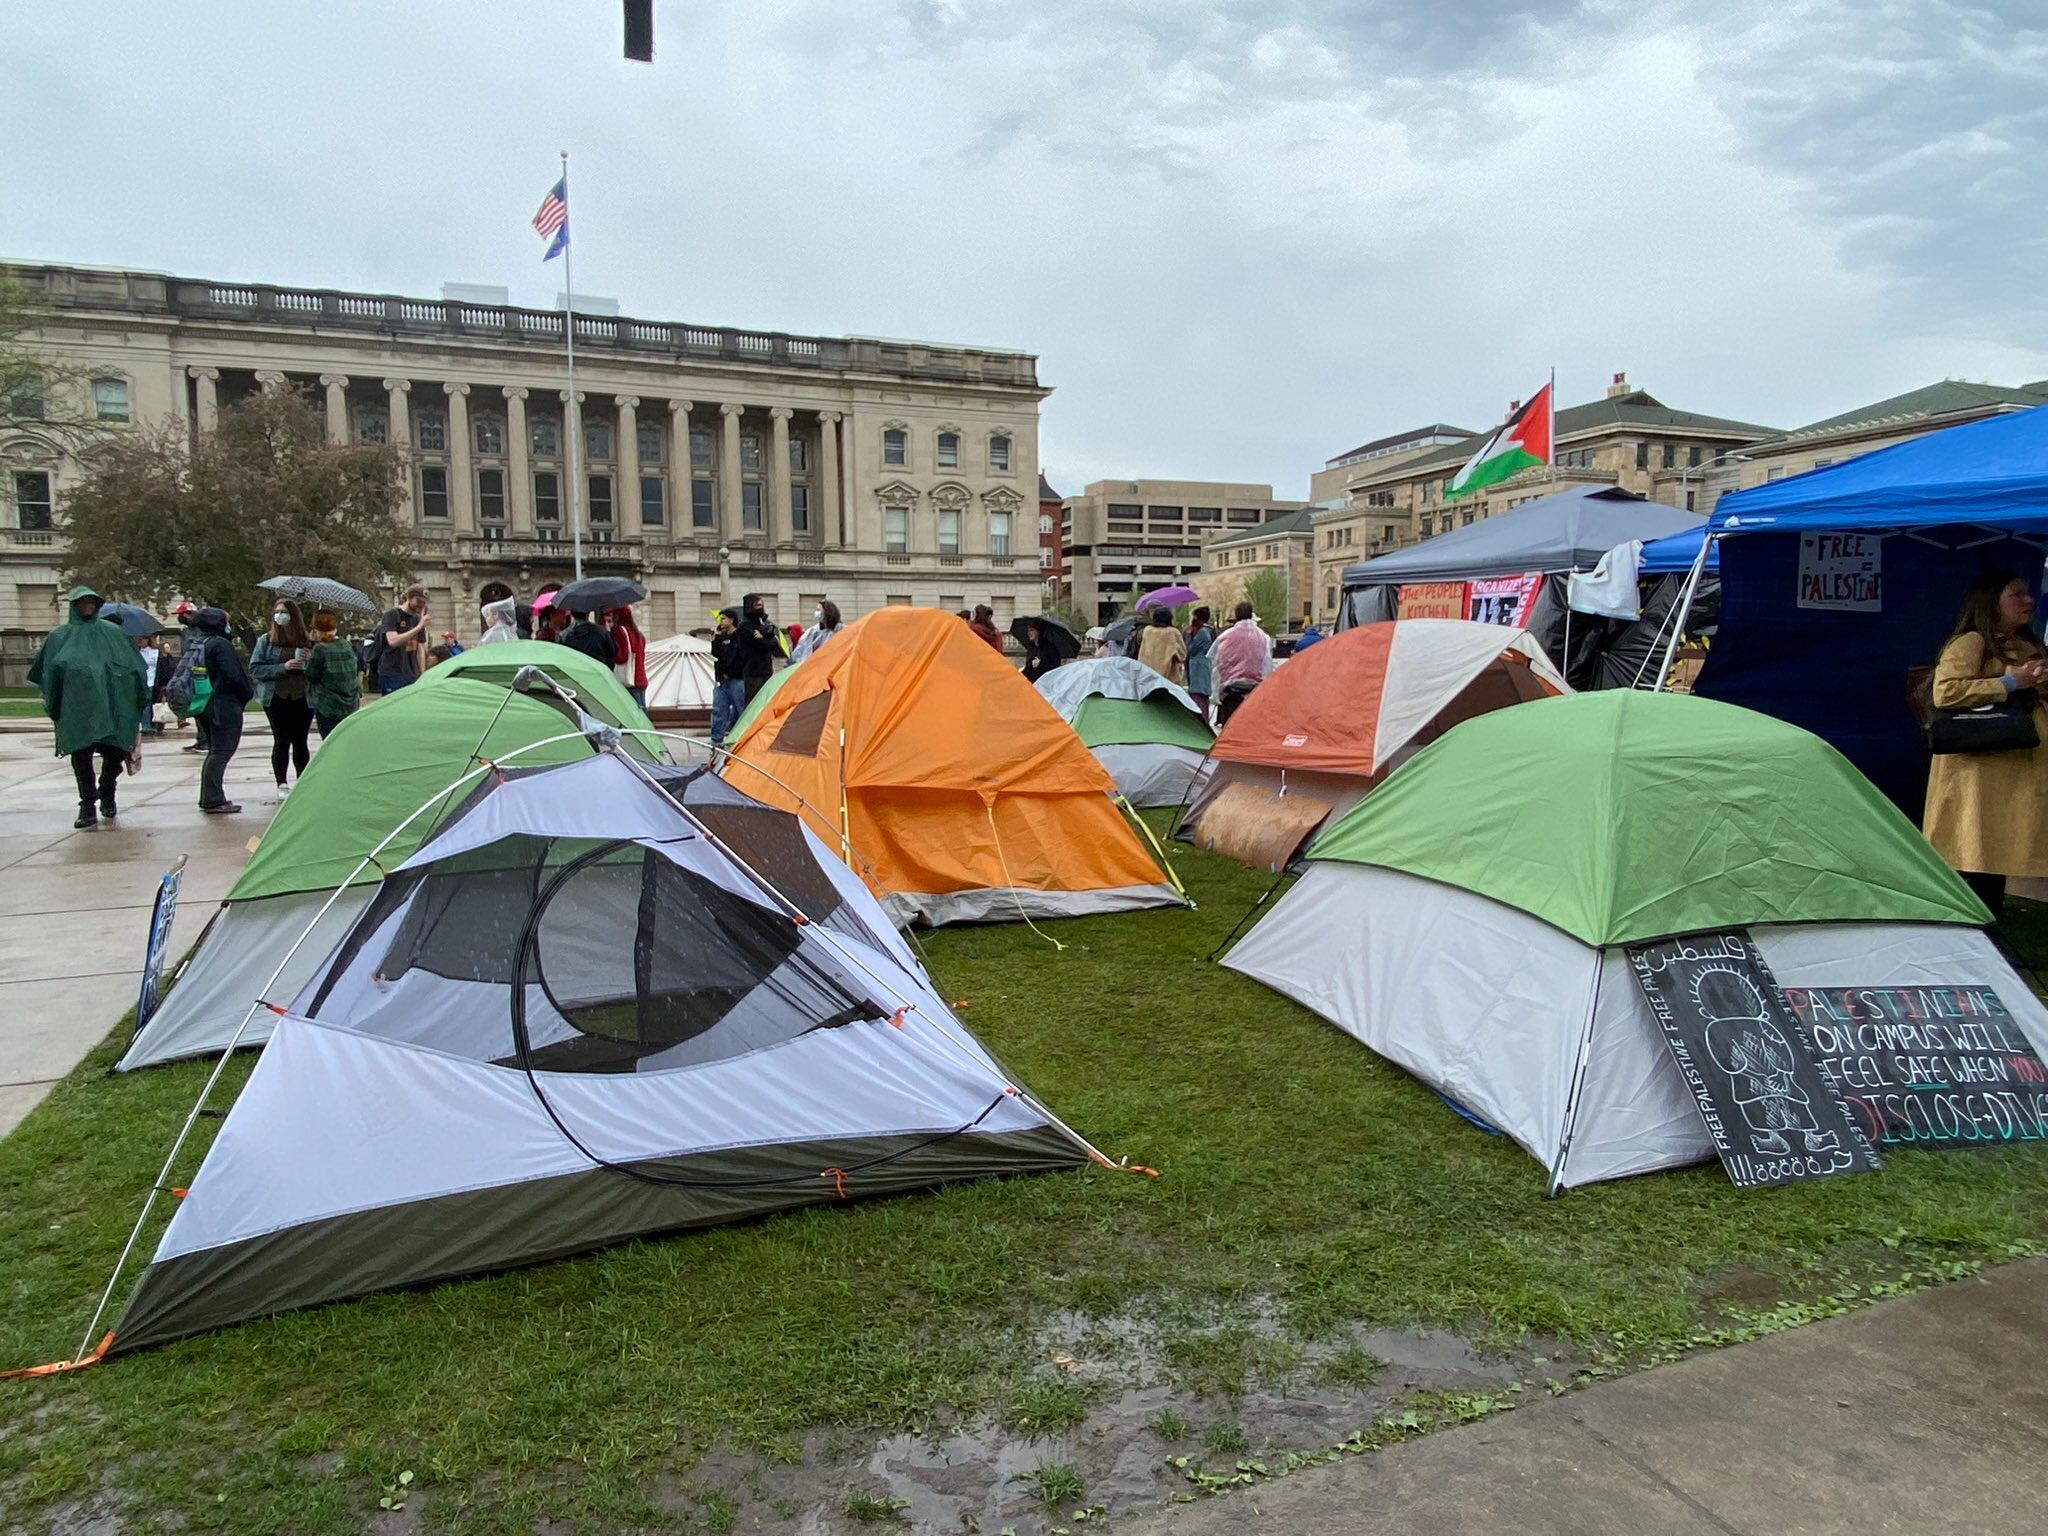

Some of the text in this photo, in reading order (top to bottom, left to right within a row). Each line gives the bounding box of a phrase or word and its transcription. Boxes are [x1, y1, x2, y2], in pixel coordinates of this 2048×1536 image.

[1818, 534, 1865, 561] FREE
[1408, 604, 1449, 619] KITCHEN
[1643, 935, 1746, 972] فلسطين
[1650, 996, 1678, 1031] FREE
[1786, 989, 2008, 1021] PALESTINIANS
[1814, 1023, 2022, 1053] ON CAMPUS WILL
[1671, 1038, 1716, 1111] PALESTINE
[1814, 1063, 1842, 1098] FREE
[1822, 1056, 2045, 1088] FEEL SAFE WHEN YOU
[1705, 1113, 1731, 1149] FREE
[1982, 1091, 2048, 1139] DIVE
